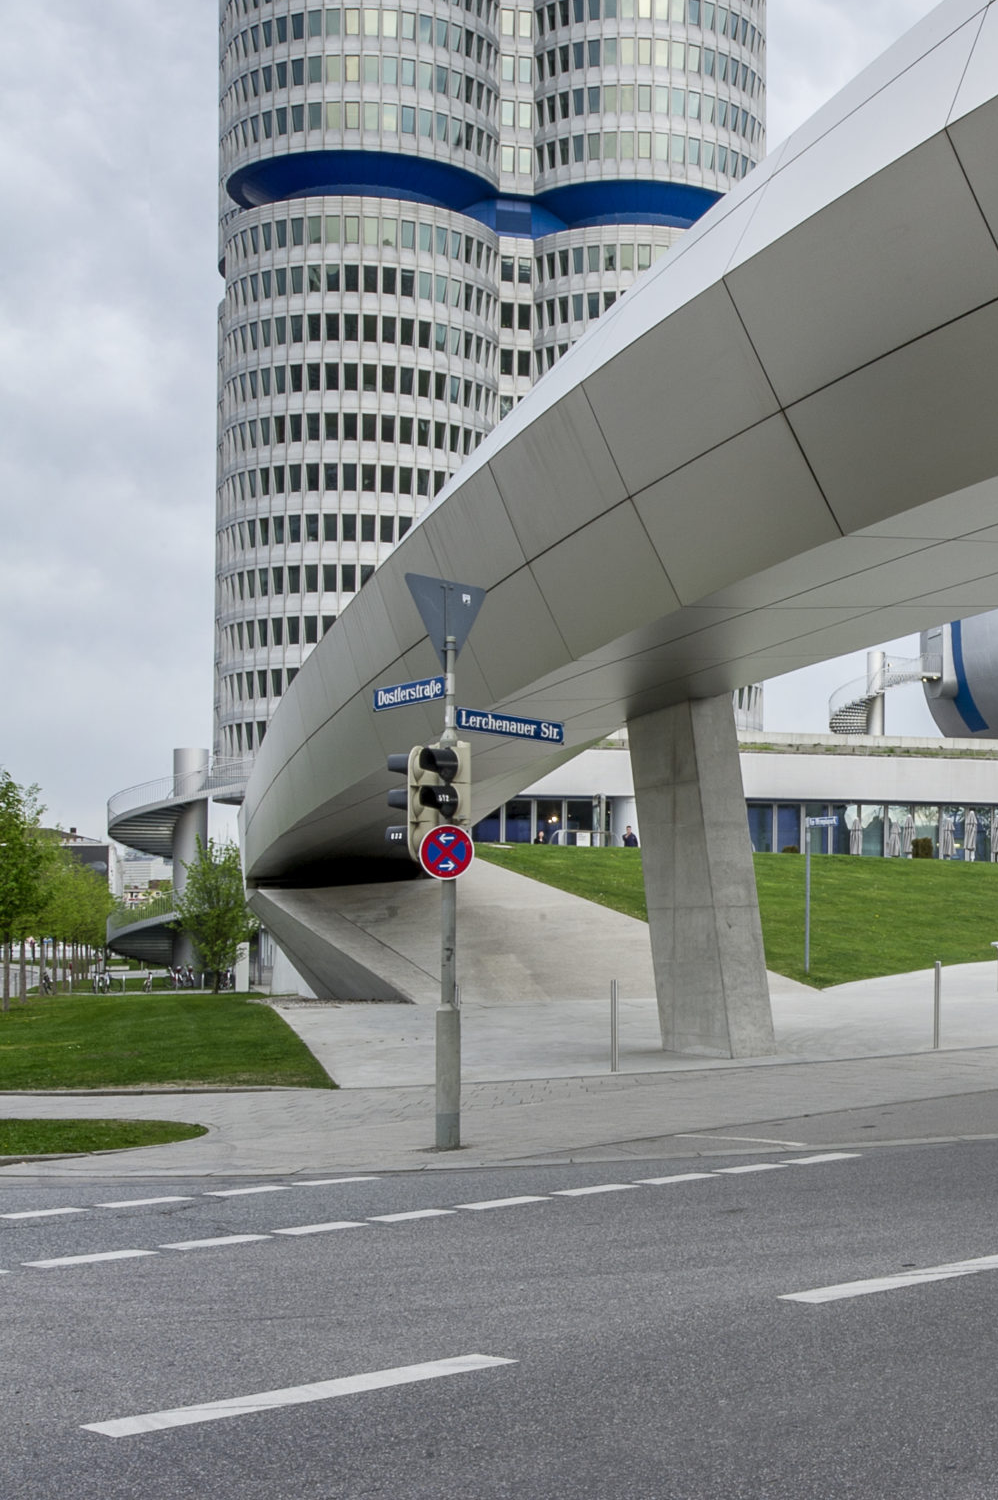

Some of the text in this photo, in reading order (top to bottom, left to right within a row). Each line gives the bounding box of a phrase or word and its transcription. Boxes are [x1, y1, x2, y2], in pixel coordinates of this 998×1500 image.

[377, 680, 442, 706] Dostlerstraße
[461, 710, 560, 740] Lerchenauer Str.
